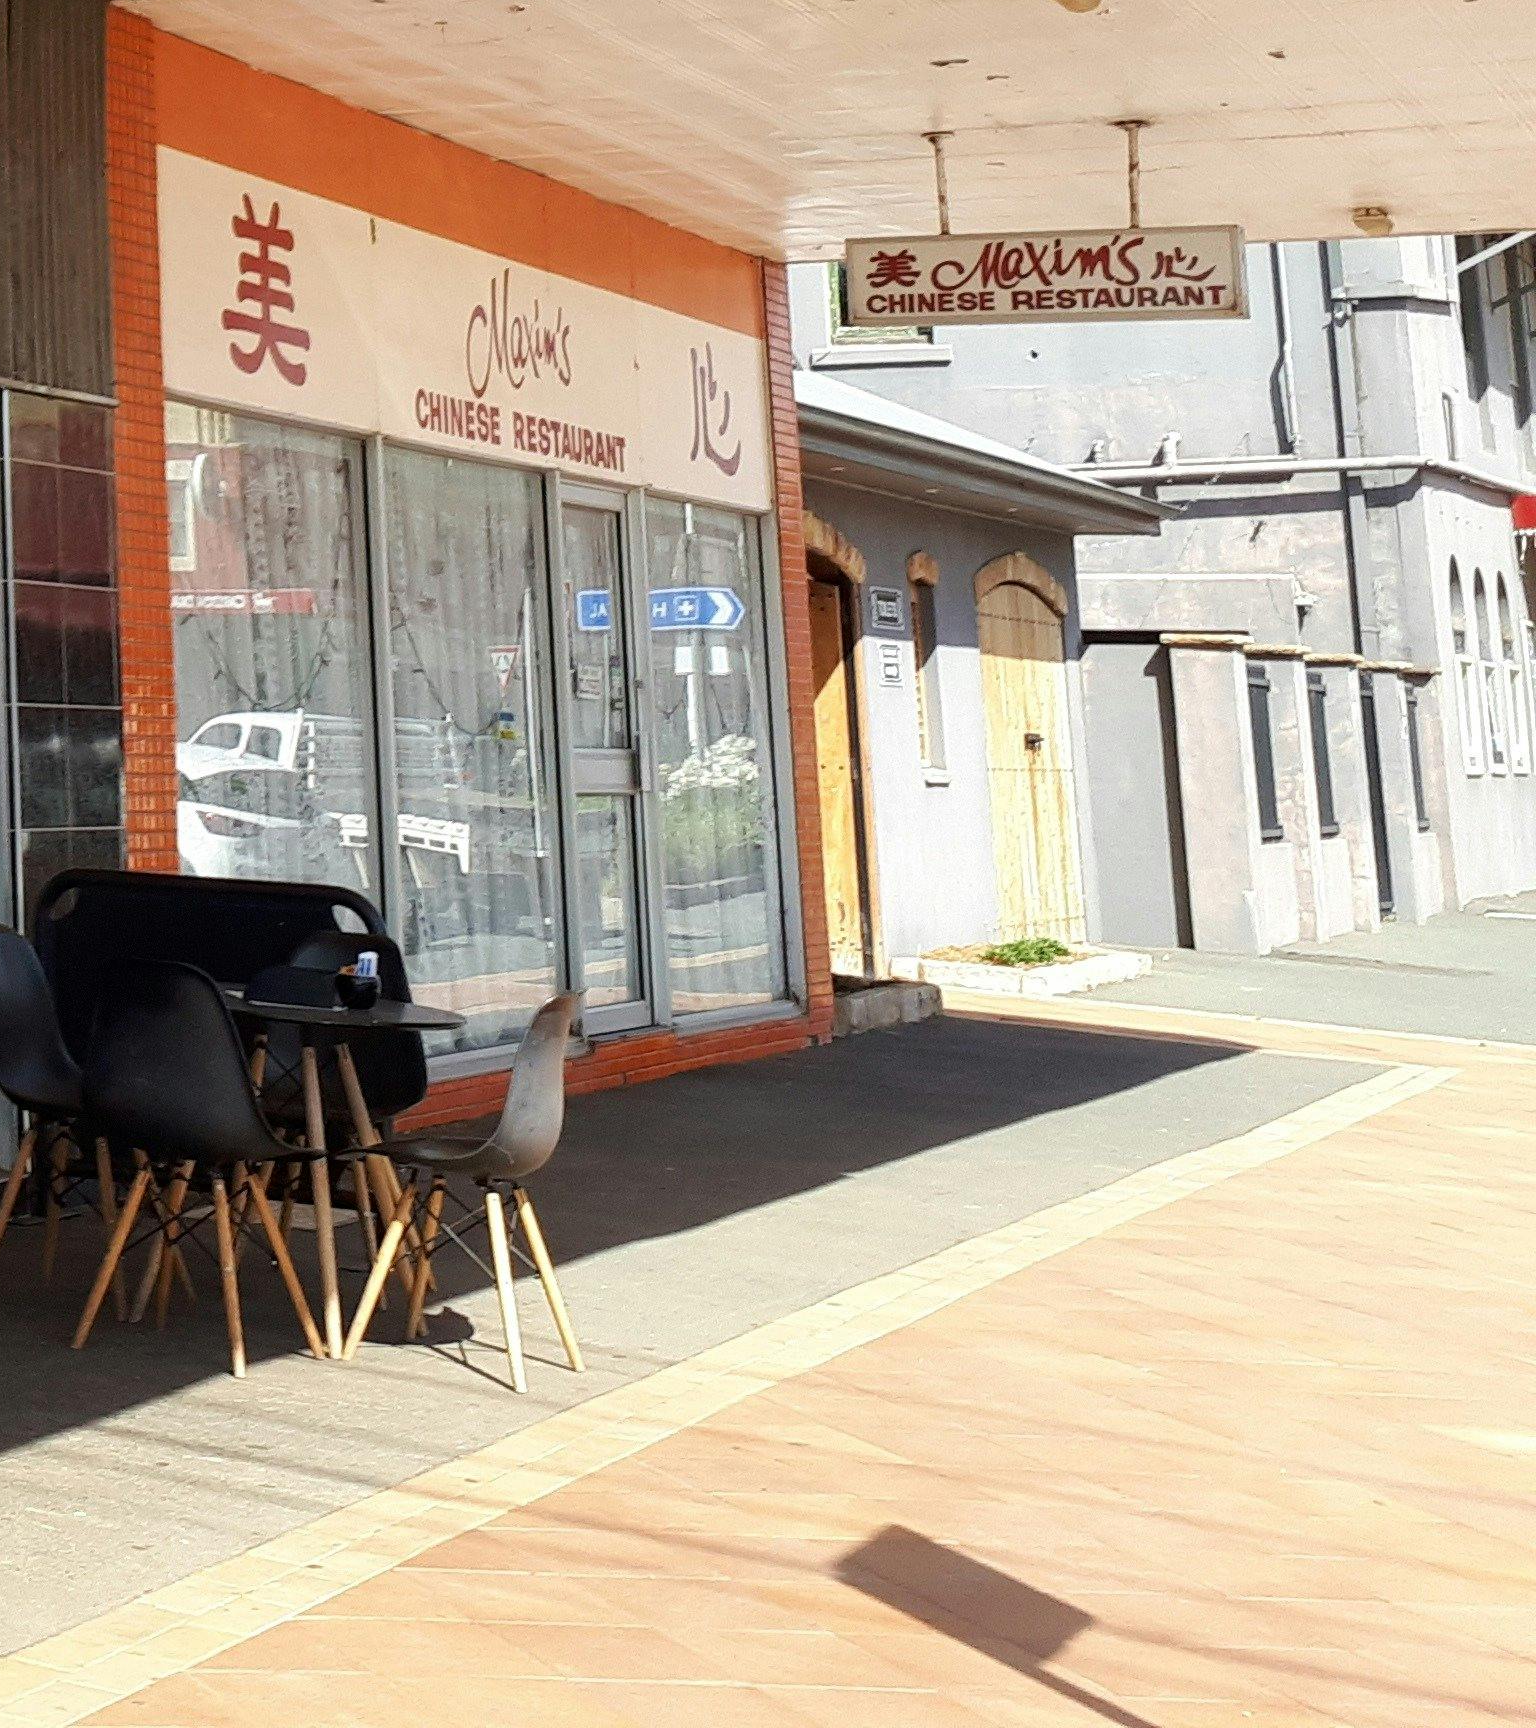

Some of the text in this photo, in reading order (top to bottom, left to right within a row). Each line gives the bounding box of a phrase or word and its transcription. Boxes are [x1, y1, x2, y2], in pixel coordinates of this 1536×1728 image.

[222, 193, 311, 386] 美
[867, 249, 921, 288] 美
[867, 284, 1227, 314] CHINESE RESTAURANT
[1152, 247, 1218, 282] 心
[466, 268, 573, 398] Maxim's
[415, 389, 627, 474] CHINESE RESTAURANT
[689, 343, 742, 477] 心
